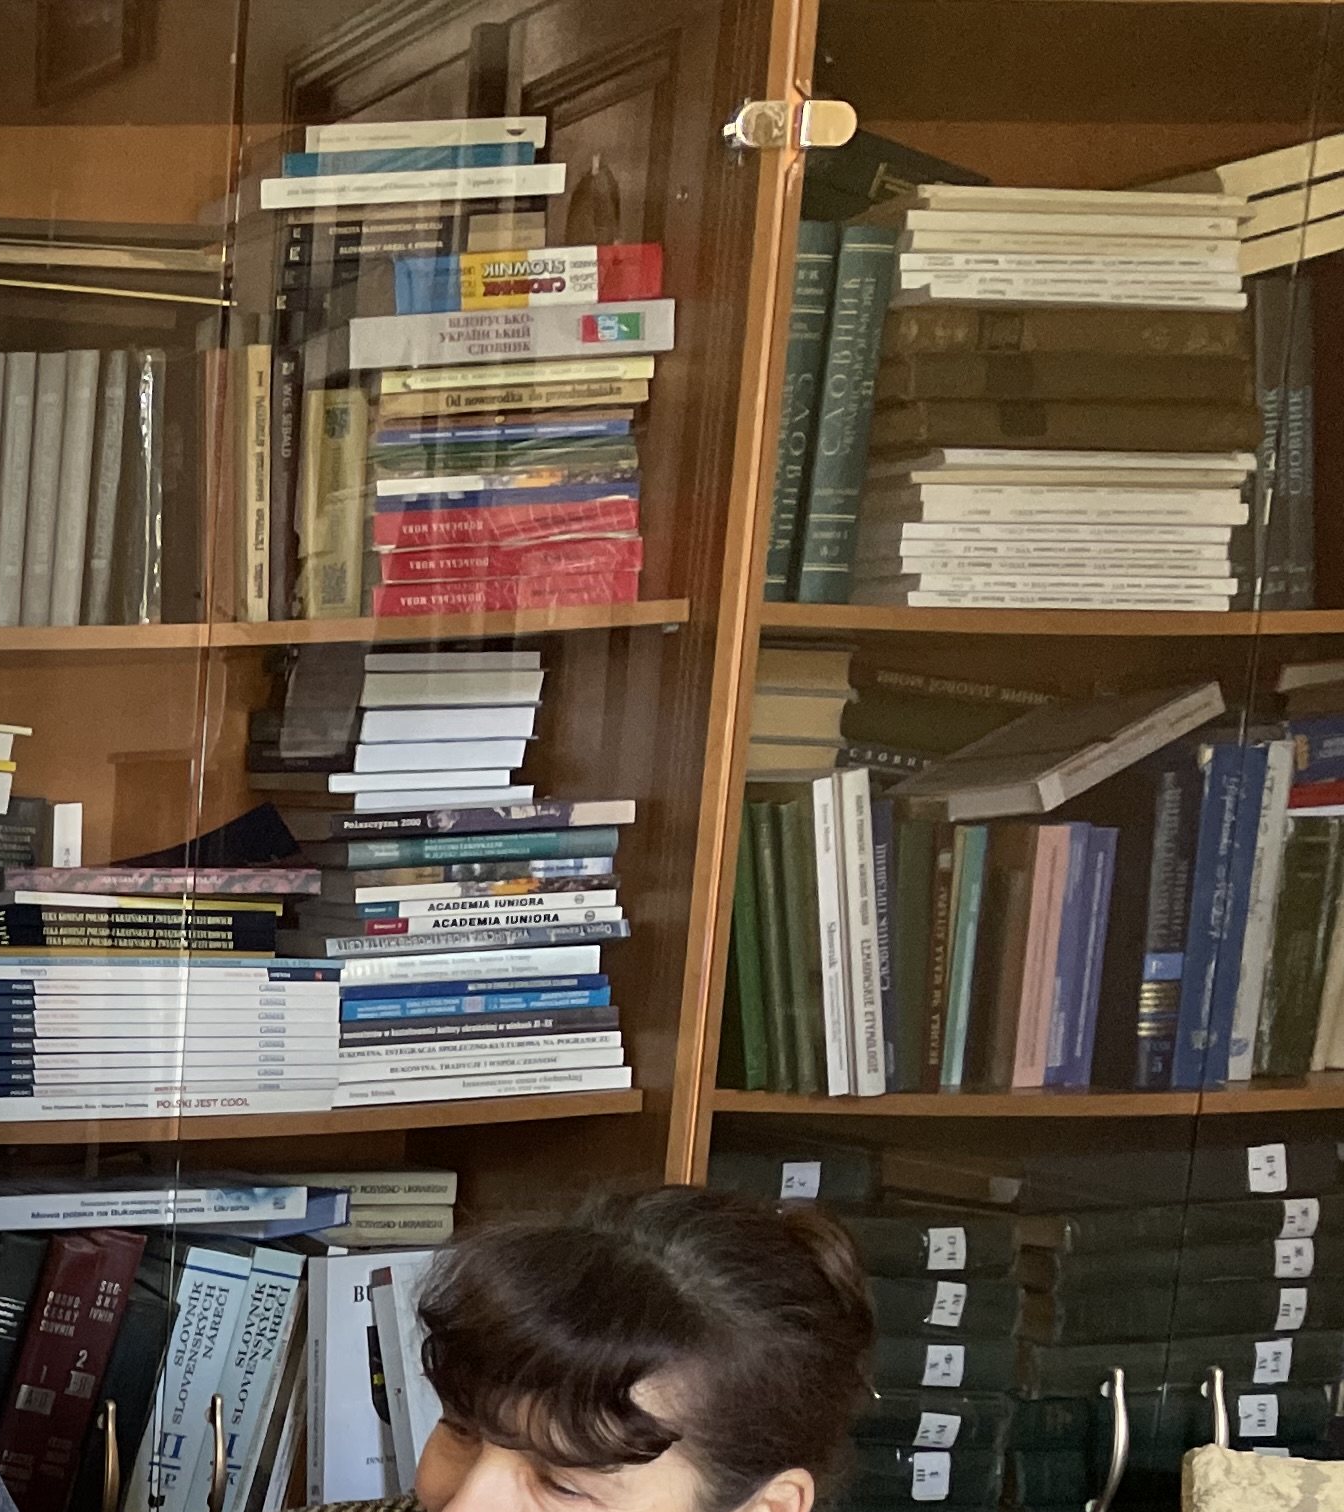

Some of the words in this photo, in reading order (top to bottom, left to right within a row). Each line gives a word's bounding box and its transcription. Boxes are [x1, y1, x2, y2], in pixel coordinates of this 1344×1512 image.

[480, 258, 565, 278] SŁOWNIK
[438, 325, 530, 343] УКРАЇНСЬКИЙ
[468, 341, 530, 354] СЛОВНИК
[817, 275, 864, 457] СЛОВНИК
[445, 394, 461, 407] Od
[279, 412, 292, 458] SEBALD
[399, 817, 422, 827] 2000
[426, 900, 490, 912] ACADEMIA
[493, 896, 544, 908] IUNIORA
[431, 915, 500, 929] ACADEMIA
[505, 912, 560, 925] IUNIORA
[862, 1010, 879, 1074] ETYMOLOGIE
[193, 1098, 216, 1108] JEST
[219, 1097, 250, 1107] COOL
[174, 1280, 205, 1366] SLOVNÍK
[202, 1285, 230, 1360] NÁREČÍ
[234, 1281, 268, 1368] SLOVNÍK
[262, 1285, 290, 1362] NÁREČÍ
[75, 1347, 90, 1368] 2
[172, 1283, 218, 1425] SLOVENSKÝCH
[231, 1283, 278, 1425] SLOVENSKÝCH
